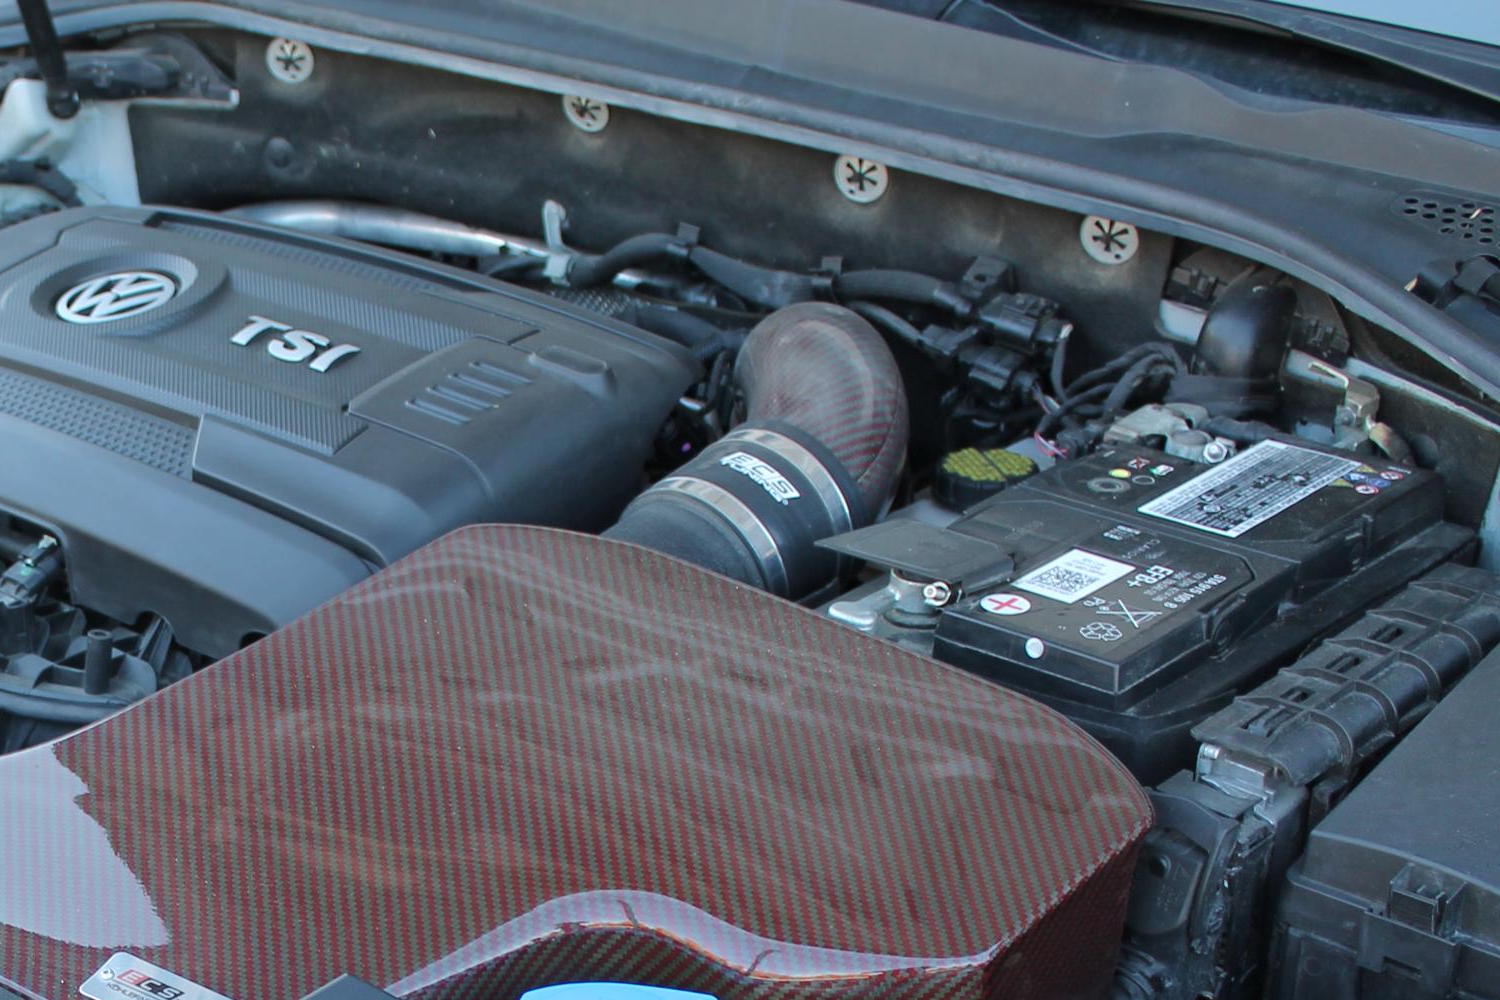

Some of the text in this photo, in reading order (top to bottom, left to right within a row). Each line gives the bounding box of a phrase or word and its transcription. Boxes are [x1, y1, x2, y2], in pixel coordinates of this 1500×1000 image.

[229, 315, 362, 373] TSI
[719, 459, 785, 504] TUNING
[724, 452, 799, 498] ECS
[1126, 564, 1175, 589] EFB+
[117, 969, 185, 1000] ECS
